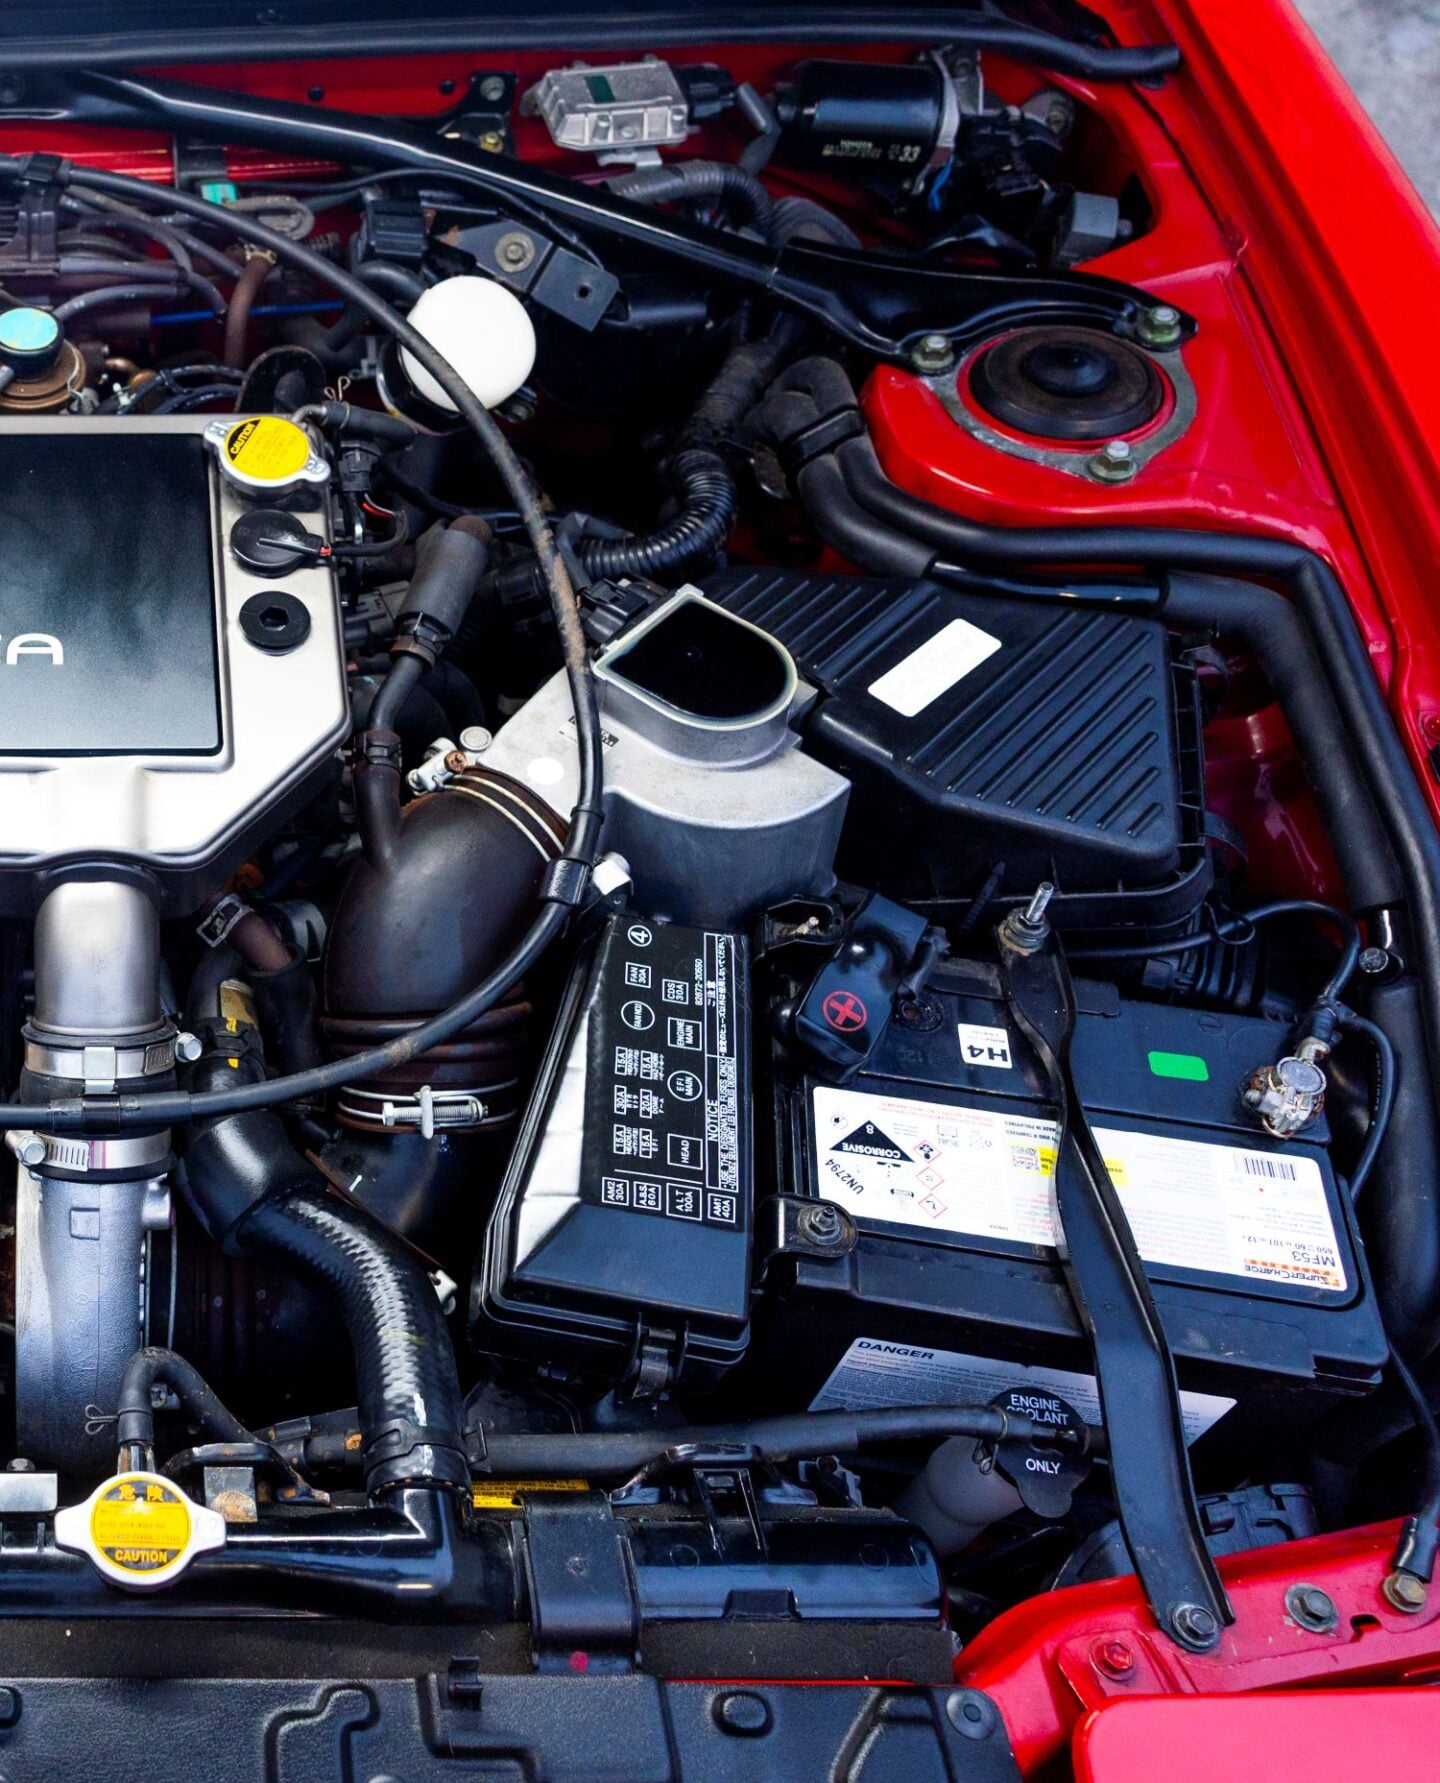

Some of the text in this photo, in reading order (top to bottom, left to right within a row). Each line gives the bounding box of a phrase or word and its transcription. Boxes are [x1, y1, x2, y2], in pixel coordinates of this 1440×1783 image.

[230, 422, 256, 455] CAUTION
[630, 967, 638, 983] FAN
[695, 958, 703, 1006] 82672-20550
[676, 984, 684, 1000] 30A
[677, 1020, 685, 1046] ENGINE
[618, 1052, 626, 1068] 15A
[967, 1044, 1009, 1062] H4
[676, 1078, 684, 1092] EFI
[685, 1076, 693, 1096] MAIN
[720, 1079, 728, 1102] FUSES
[616, 1091, 624, 1109] 30A
[642, 1094, 650, 1112] 20A
[707, 1099, 718, 1142] NOTICE
[720, 1104, 728, 1150] DESIGNATED
[866, 1124, 874, 1134] 8
[615, 1130, 624, 1147] 15A
[642, 1134, 650, 1152] 15A
[681, 1140, 689, 1164] HEAD
[842, 1142, 901, 1158] CORROSIVE
[825, 1158, 864, 1195] UN2794
[616, 1183, 624, 1200] 30A
[648, 1187, 656, 1206] 60A
[685, 1192, 693, 1212] 100A
[713, 1198, 721, 1216] AM1
[722, 1200, 730, 1218] 40A
[1292, 1251, 1335, 1267] MF53
[857, 1340, 935, 1361] DANGER
[1010, 1393, 1062, 1412] ENGINE
[1006, 1405, 1069, 1426] OLANT
[1025, 1458, 1061, 1475] ONLY
[115, 1549, 168, 1563] CAUTION
